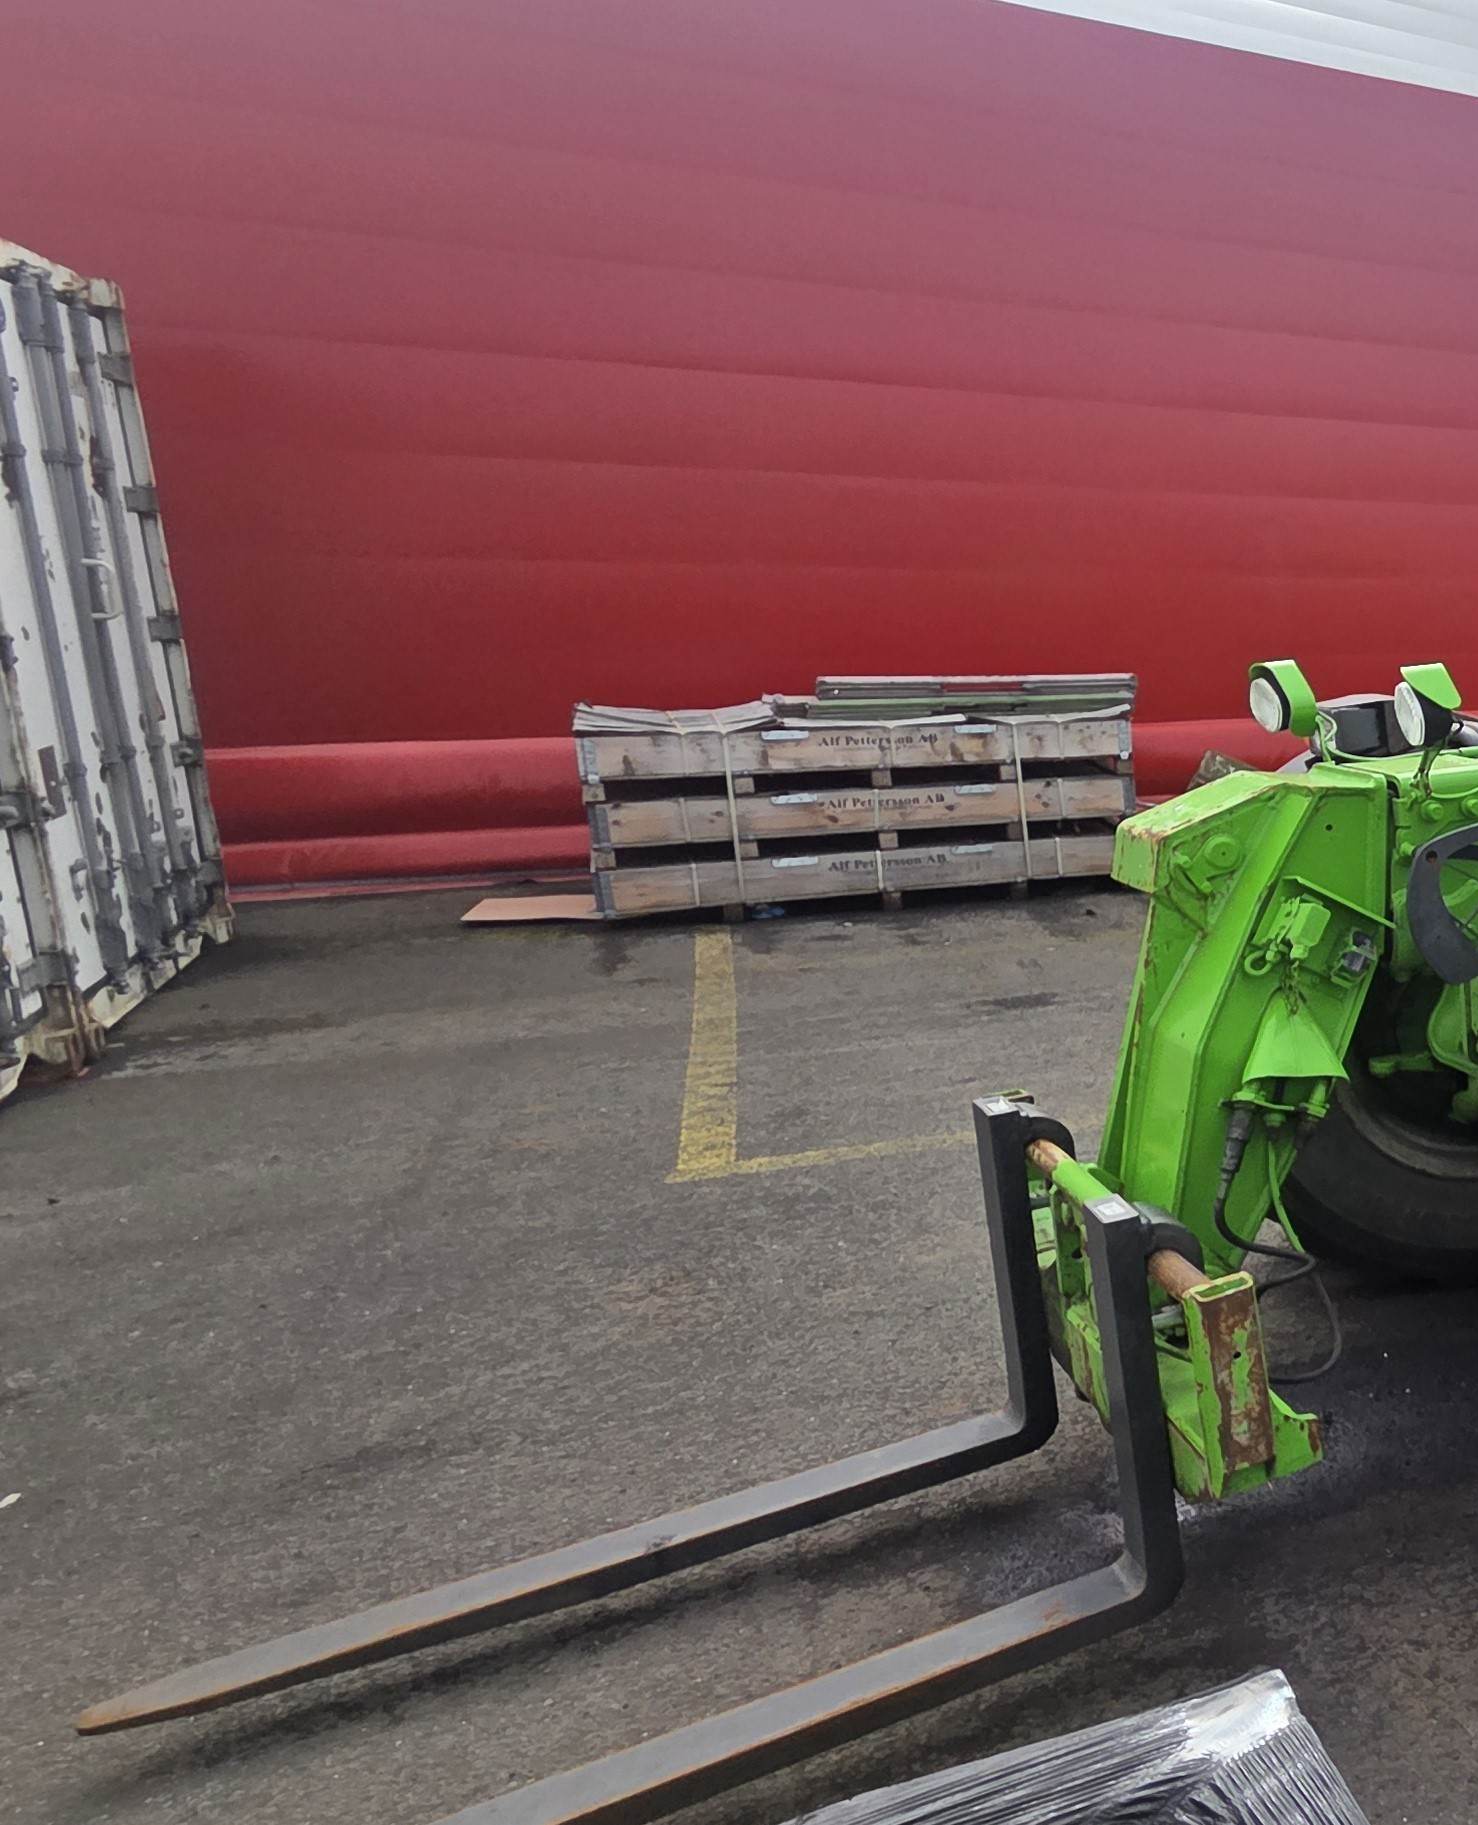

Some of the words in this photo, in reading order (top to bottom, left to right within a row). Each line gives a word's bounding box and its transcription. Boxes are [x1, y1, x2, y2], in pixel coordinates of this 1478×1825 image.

[818, 735, 841, 747] Alf
[846, 734, 914, 746] Petterson
[918, 733, 938, 743] AB
[827, 798, 848, 809] Alf
[853, 796, 920, 808] Petersson
[924, 793, 945, 804] AB
[828, 860, 852, 872] Alf
[854, 856, 922, 869] Petersson
[926, 854, 947, 865] AB
